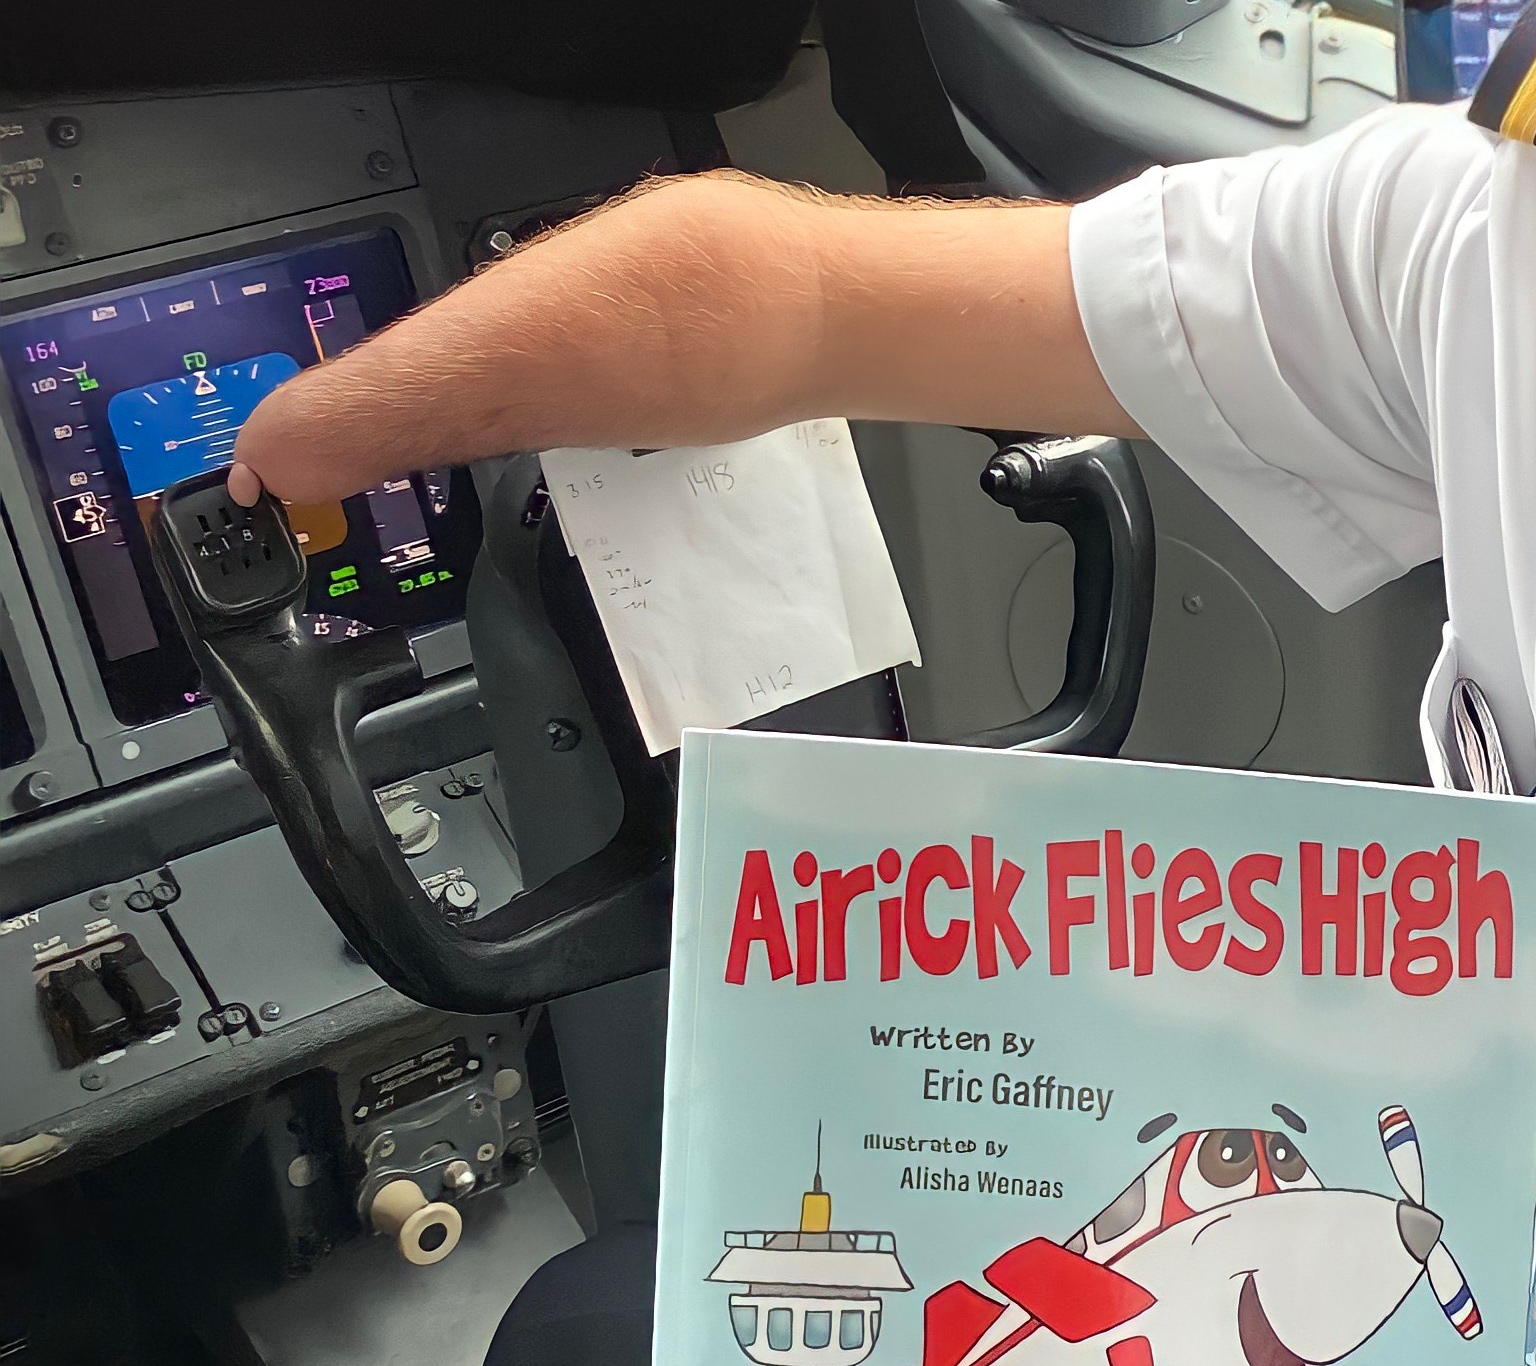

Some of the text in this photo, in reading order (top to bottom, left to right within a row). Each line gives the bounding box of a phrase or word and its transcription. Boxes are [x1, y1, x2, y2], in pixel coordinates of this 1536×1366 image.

[1046, 829, 1285, 977] Flies
[1299, 838, 1514, 997] High
[870, 1025, 1035, 1058] Written By
[923, 1068, 1115, 1122] Eric Gaffney
[985, 1140, 1009, 1158] By
[900, 1166, 1064, 1199] Alisha Wenaas
